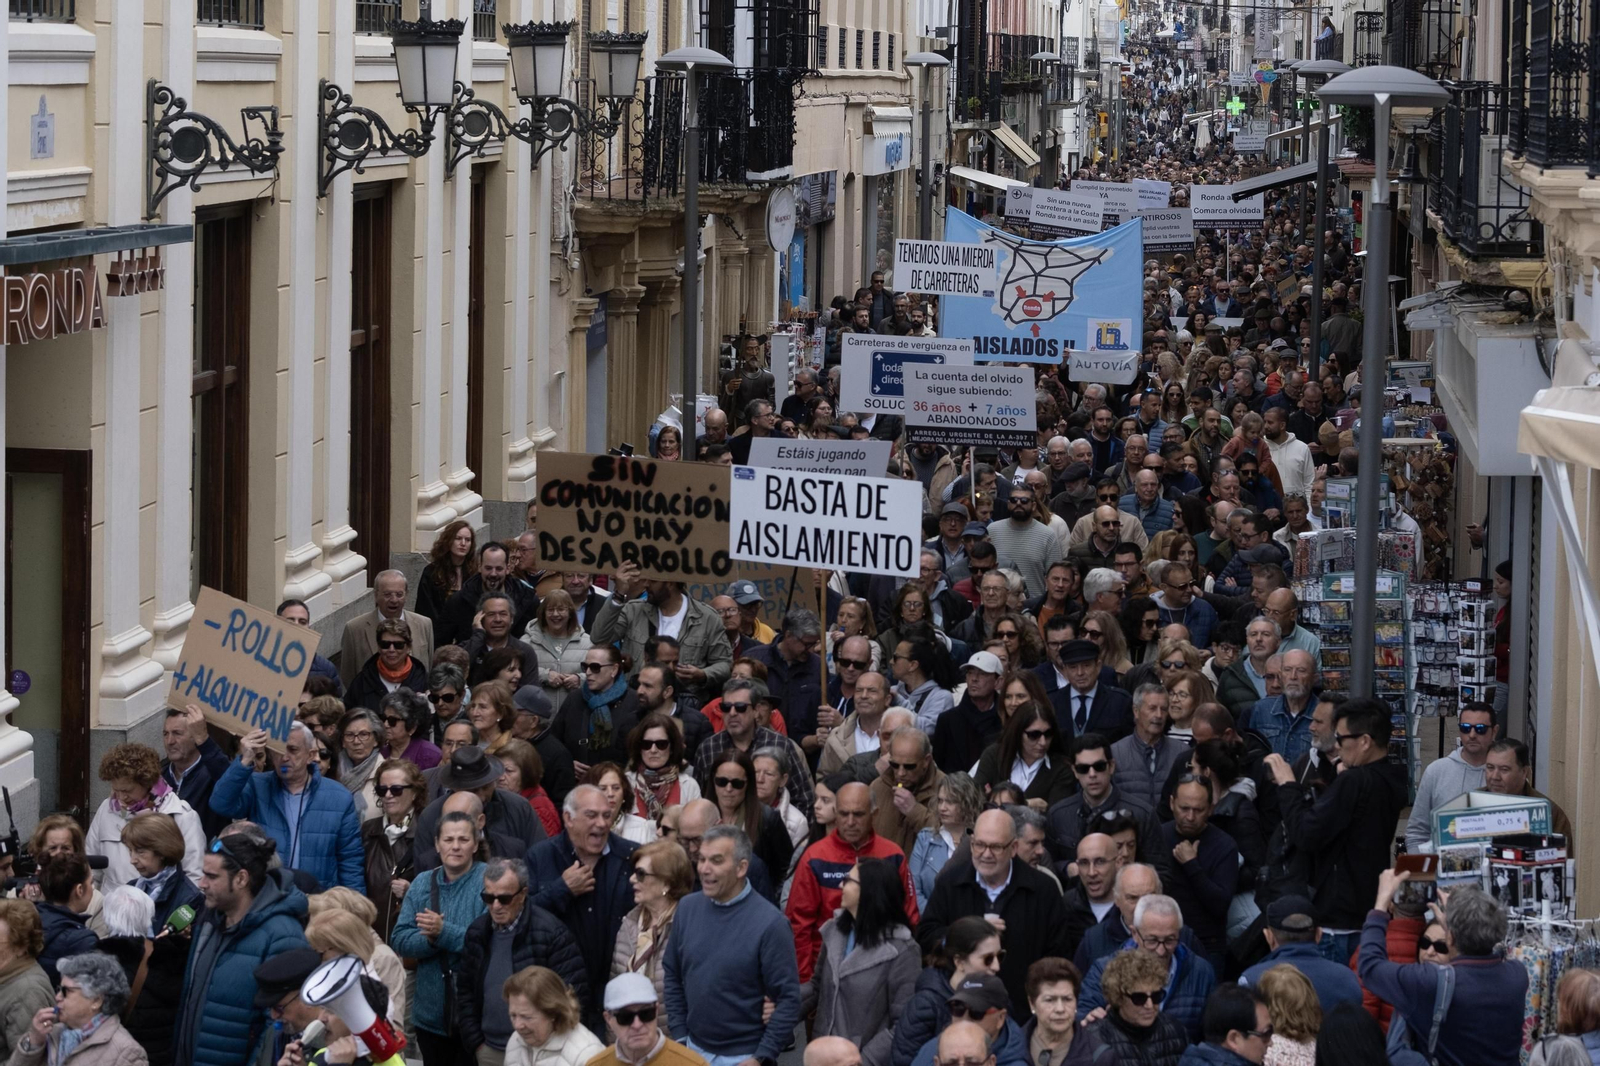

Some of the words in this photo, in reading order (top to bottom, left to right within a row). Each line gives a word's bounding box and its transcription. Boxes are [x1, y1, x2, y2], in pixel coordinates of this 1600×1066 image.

[1076, 183, 1098, 192] Cumplid
[1105, 186, 1134, 194] prometido
[1014, 207, 1024, 215] YA
[1036, 204, 1067, 213] carretera
[1073, 207, 1079, 215] la
[1080, 209, 1100, 218] Costa
[1072, 201, 1091, 209] nueva
[1229, 206, 1261, 214] olvidada
[1035, 210, 1056, 219] Ronda
[1057, 213, 1073, 221] será
[1082, 217, 1099, 226] asilo
[1131, 213, 1182, 222] MNTIROSOS
[1168, 231, 1192, 239] Serranía
[898, 242, 939, 265] TENEMOS
[941, 244, 961, 266] UNA
[961, 246, 994, 269] MIERDA
[911, 269, 922, 290] DE
[924, 271, 980, 294] CARRETERAS
[847, 337, 897, 349] Carreteras
[898, 341, 910, 349] de
[911, 340, 957, 352] vergüenza
[973, 336, 1059, 357] AISLADOS
[881, 363, 903, 373] toda
[1075, 357, 1132, 372] AUTOVÍA
[881, 376, 904, 386] direc
[915, 370, 929, 381] La
[931, 372, 969, 383] cuenta
[971, 370, 988, 383] del
[990, 373, 1023, 385] olvido
[927, 386, 957, 396] sigue
[959, 386, 1012, 397] subiendo:
[864, 398, 906, 411] SOLUC
[913, 401, 929, 412] 36
[931, 402, 962, 413] años
[985, 404, 993, 415] 7
[996, 404, 1027, 416] años
[927, 415, 1017, 427] ABANDONADOS
[777, 446, 815, 459] Estáis
[816, 449, 866, 462] jugando
[588, 455, 658, 487] SIN
[765, 475, 848, 518] BASTA
[856, 483, 889, 521] DE
[576, 508, 626, 537] NO
[633, 514, 694, 545] HAY
[736, 519, 914, 572] AISLAMIENTO
[538, 531, 734, 577] DESARROLLO
[689, 576, 804, 601] CARTERA
[1497, 818, 1514, 826] 0,75
